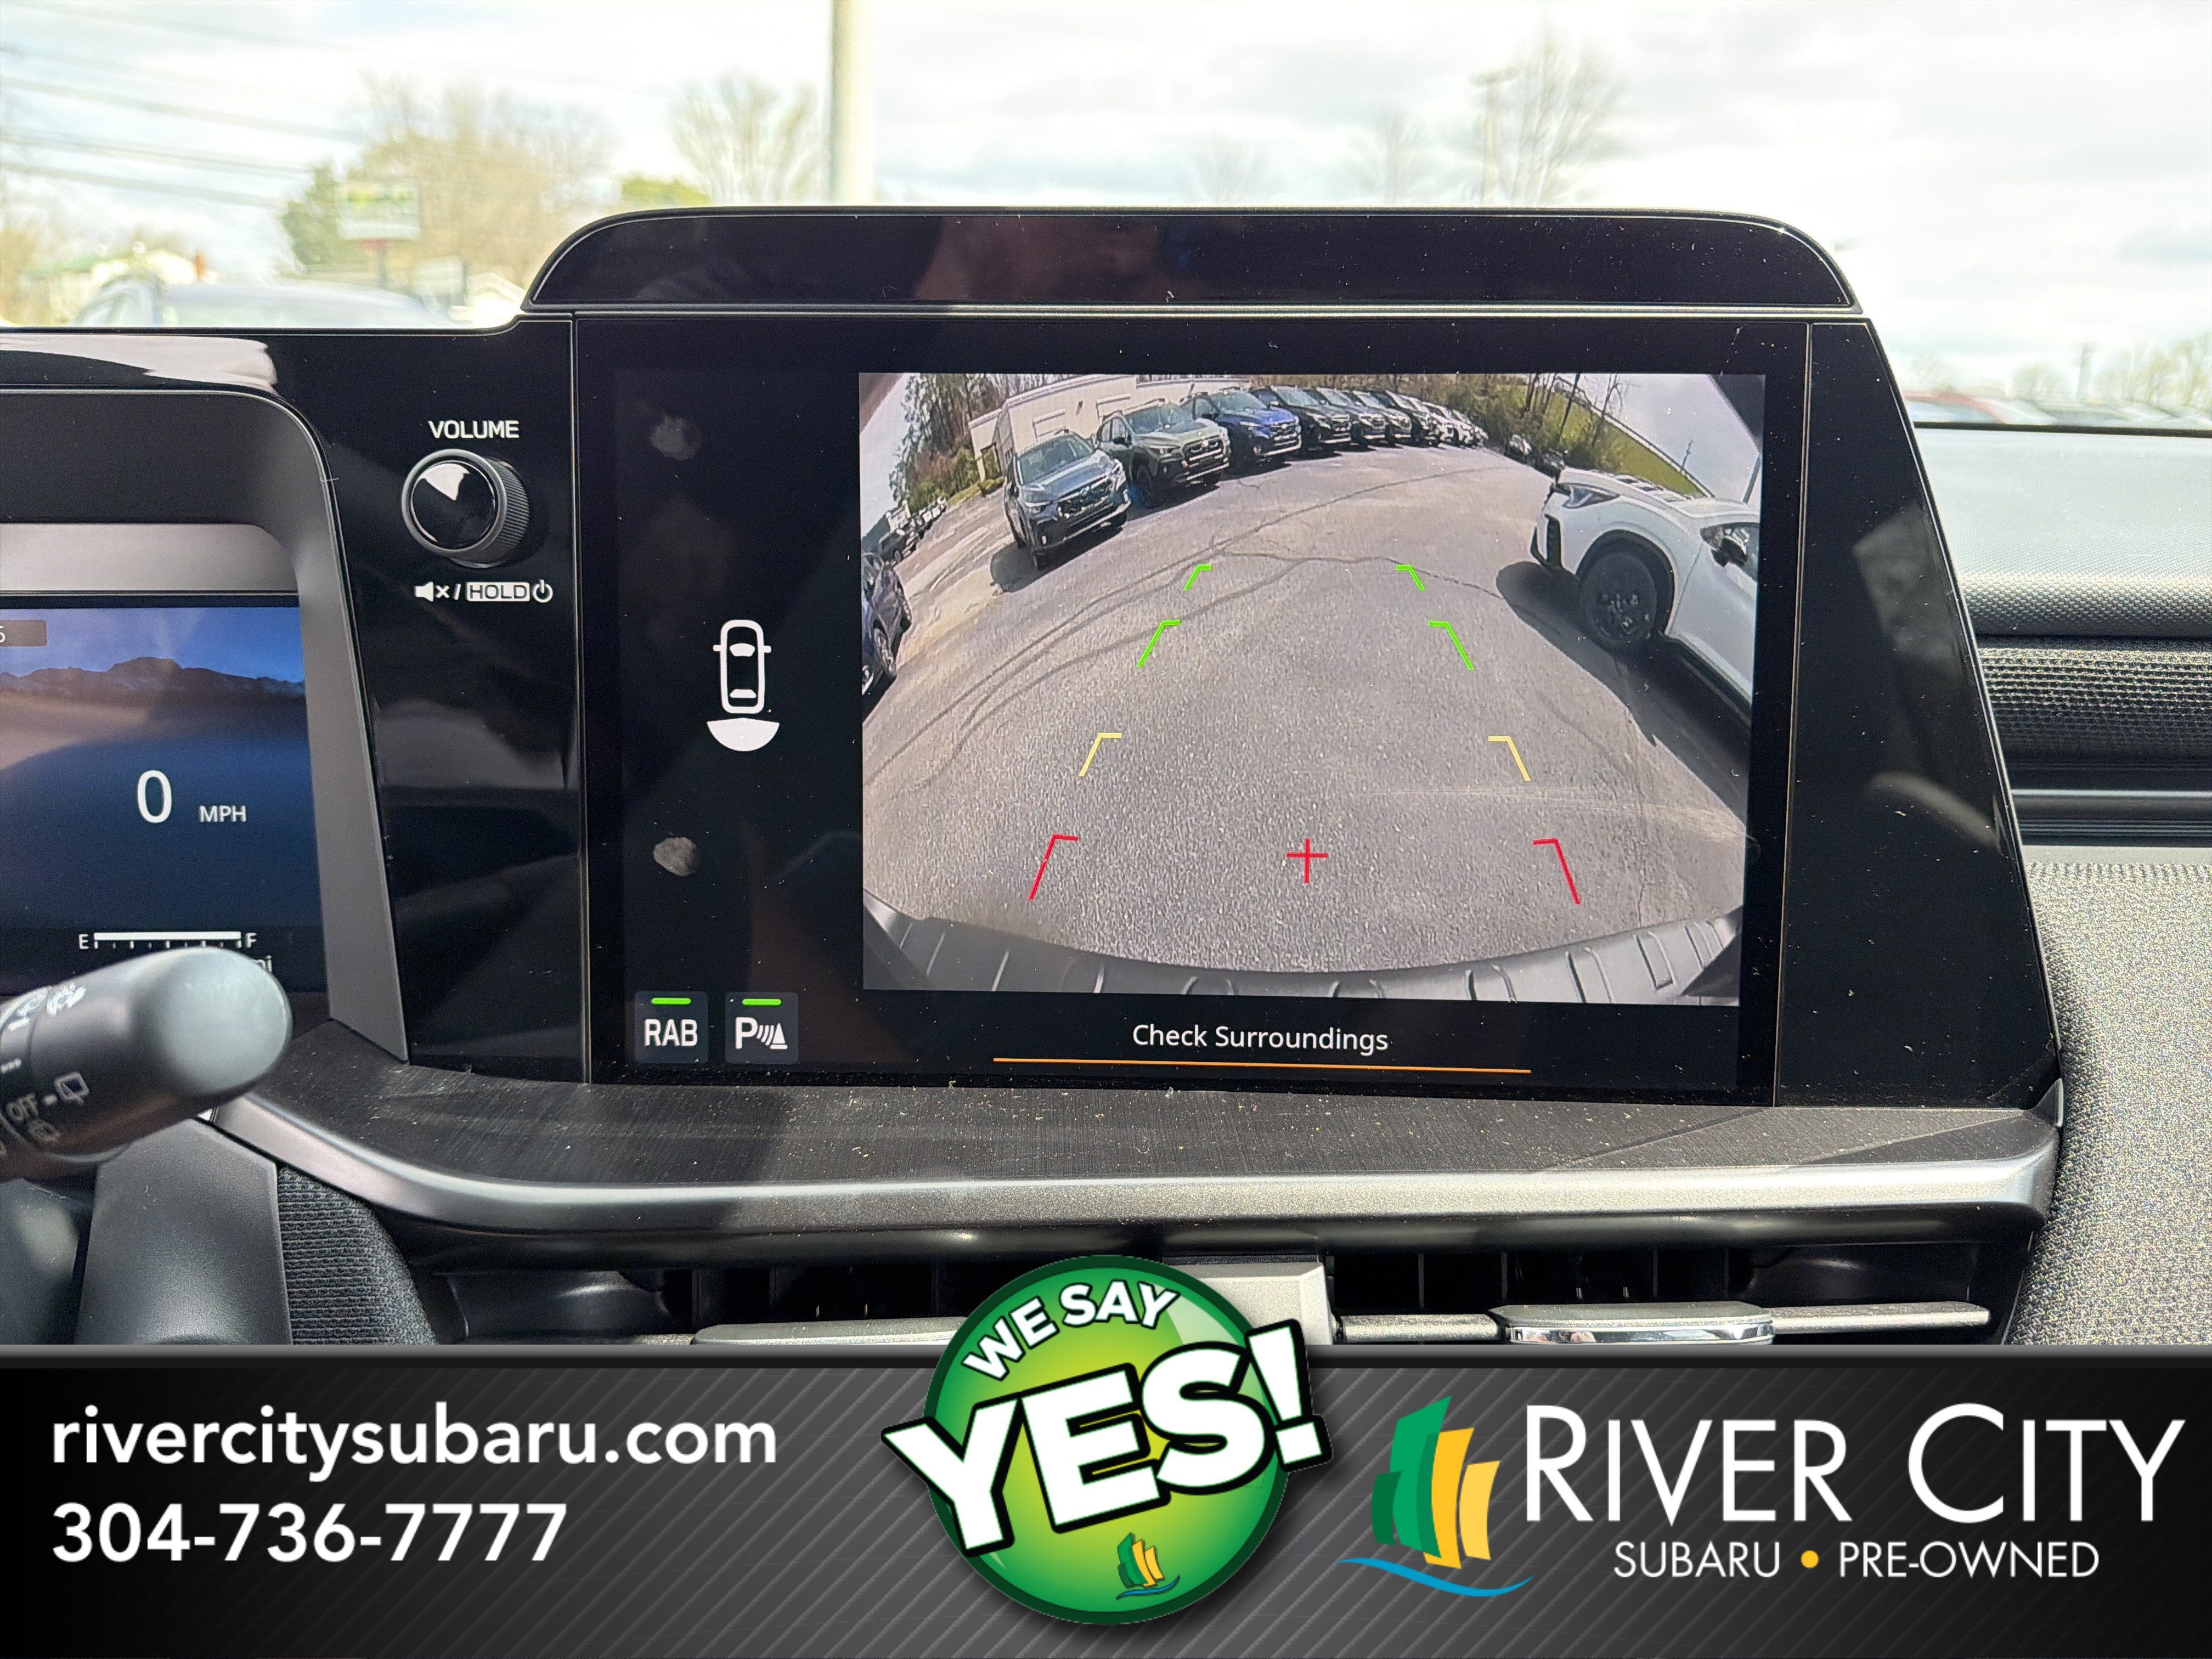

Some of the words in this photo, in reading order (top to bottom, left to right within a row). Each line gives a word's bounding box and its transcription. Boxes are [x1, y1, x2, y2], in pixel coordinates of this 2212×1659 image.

[428, 420, 520, 439] VOLUME
[469, 583, 528, 600] HOLD
[137, 770, 172, 823] 0
[199, 805, 247, 822] MPH
[79, 934, 89, 950] E
[245, 932, 257, 948] F
[644, 1019, 698, 1047] RAB
[1133, 1024, 1207, 1047] Check
[1215, 1026, 1389, 1056] Surroundings
